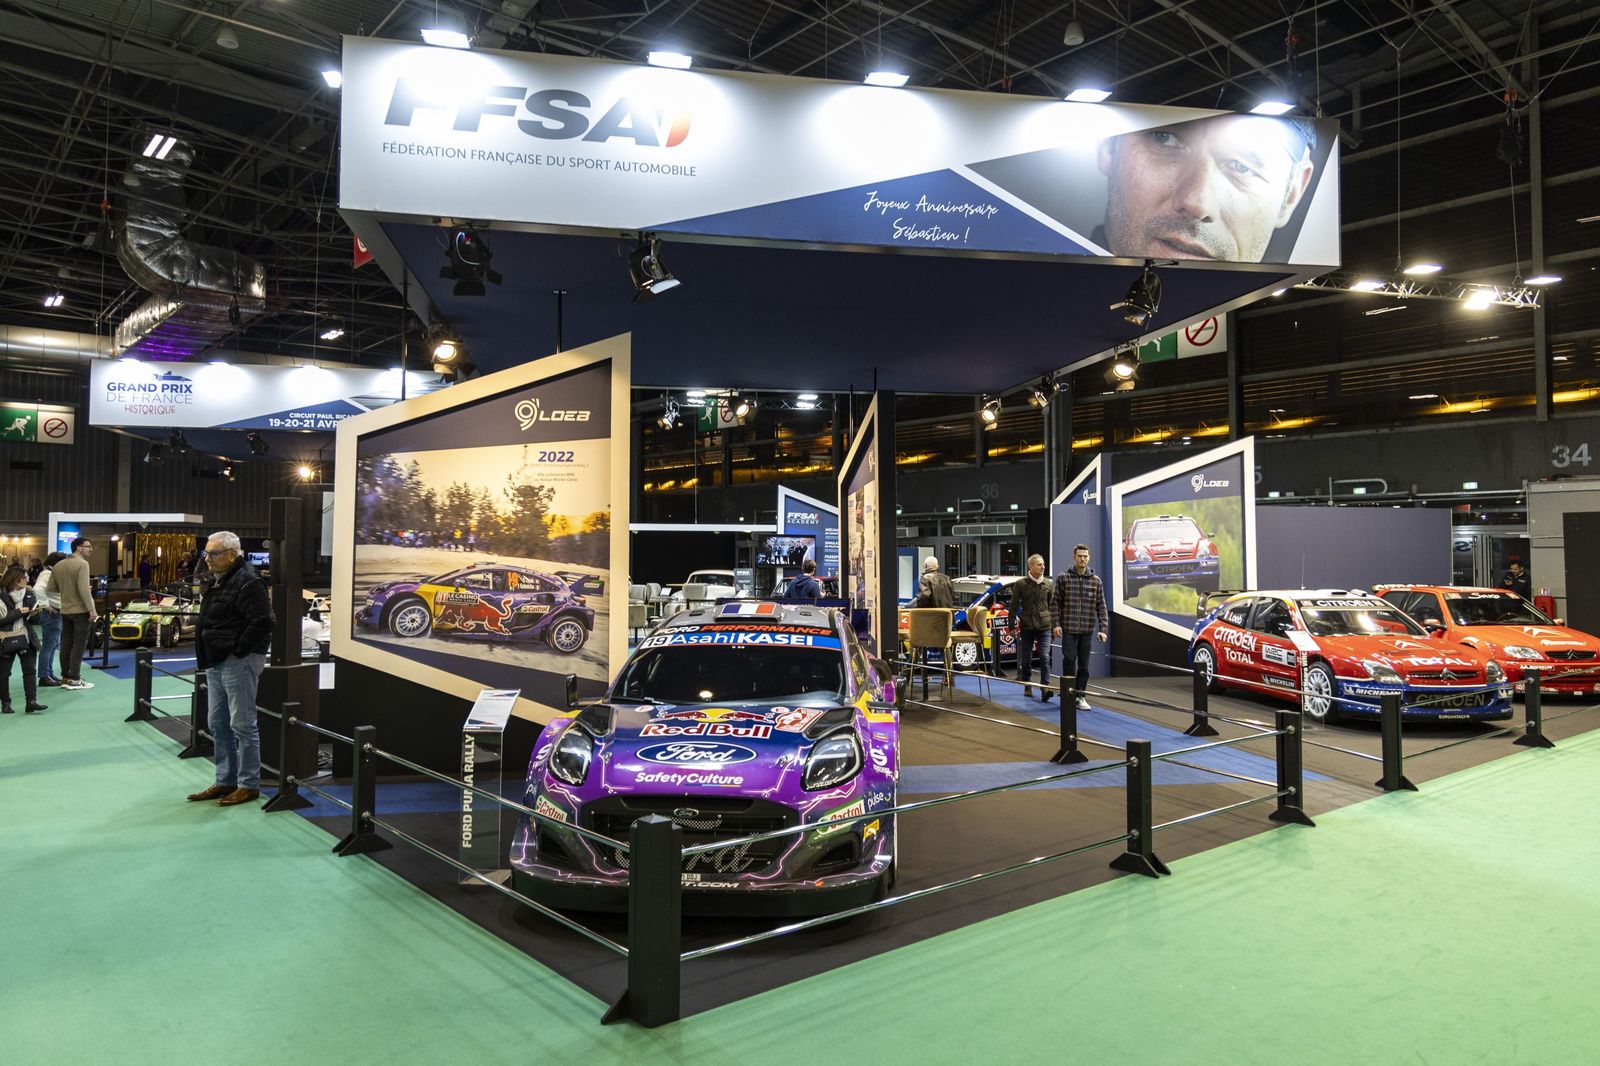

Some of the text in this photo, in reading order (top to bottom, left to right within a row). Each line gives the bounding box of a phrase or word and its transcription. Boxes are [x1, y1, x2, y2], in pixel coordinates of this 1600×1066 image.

[382, 140, 697, 177] FÉDÉRATION FRANÇAISE DU SPORT AUTOMOBILE
[864, 190, 999, 219] Joyeux Anniversaire
[892, 217, 959, 242] Sébastien
[107, 382, 193, 393] GRAND PRIX
[106, 391, 192, 404] DE FRANCE
[125, 404, 176, 415] HISTORIQUE
[539, 410, 591, 422] LOEB
[269, 418, 314, 428] 19-20-21
[538, 451, 575, 462] 2022
[1551, 443, 1592, 468] 34
[1229, 612, 1242, 624] Loeb
[655, 624, 832, 636] FORD PERFORMANCE
[1214, 626, 1257, 651] CITROËN
[1224, 647, 1254, 664] TOTAL
[640, 722, 774, 740] Red Bull
[464, 734, 475, 772] RALLY
[656, 743, 737, 763] Ford
[635, 772, 744, 786] SafetyCulture
[462, 814, 472, 848] FORD
